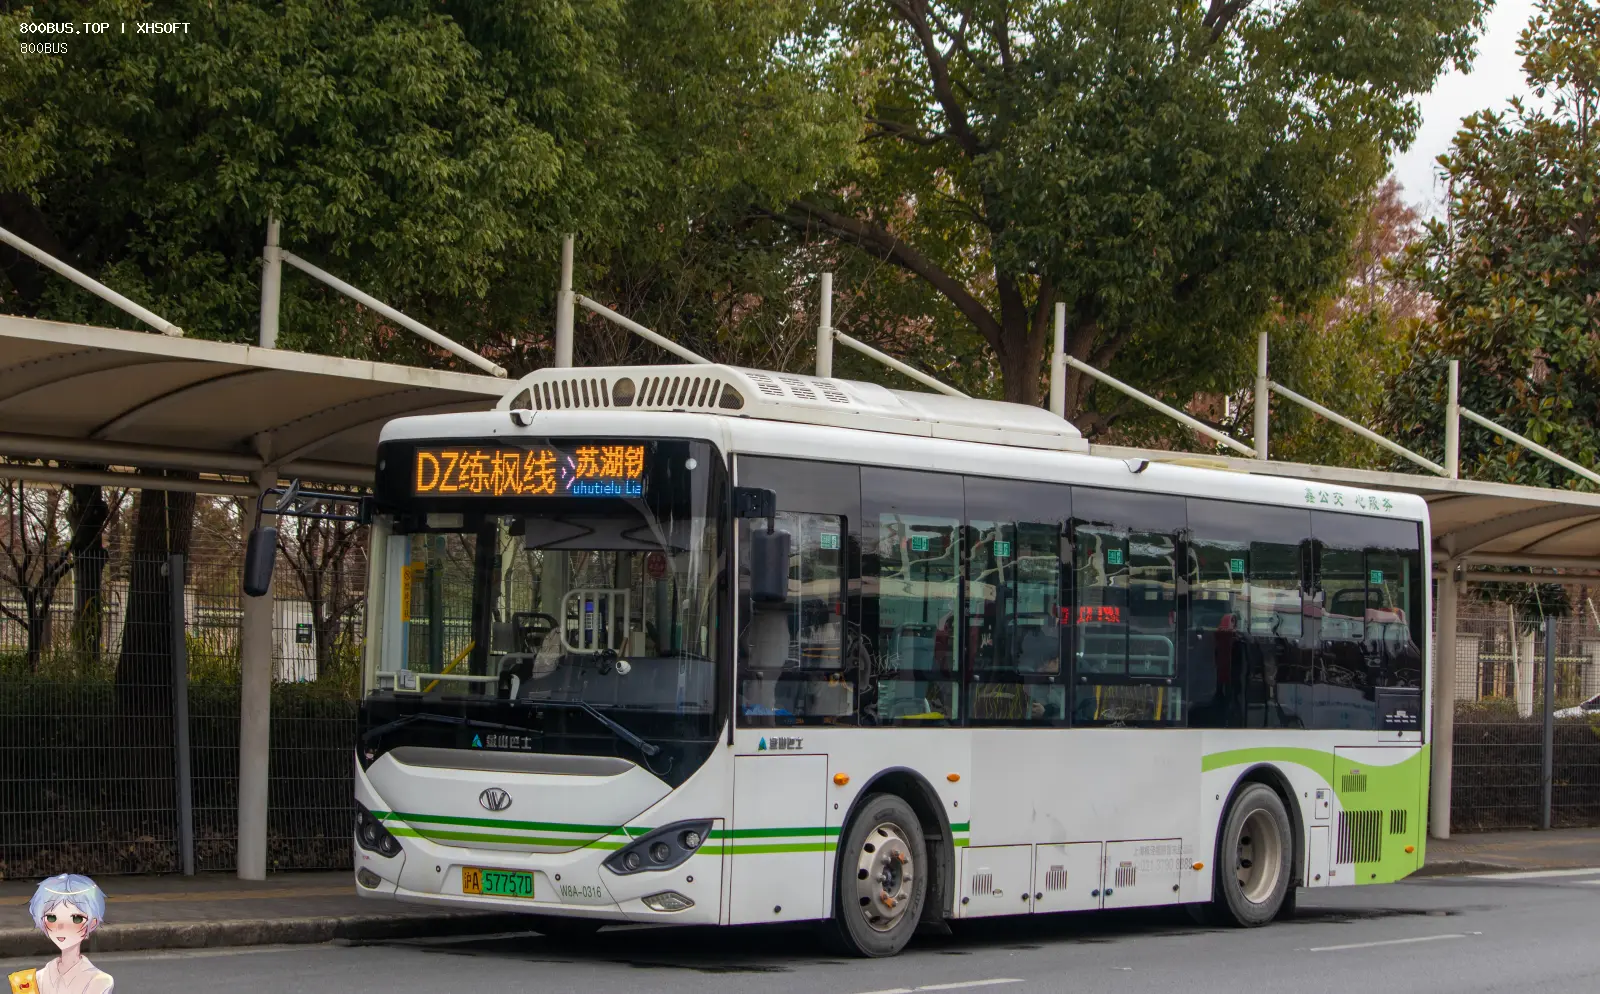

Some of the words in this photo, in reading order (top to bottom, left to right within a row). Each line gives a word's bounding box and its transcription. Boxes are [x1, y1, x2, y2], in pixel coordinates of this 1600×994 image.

[416, 450, 557, 496] DZ练枫线
[560, 884, 602, 898] W8A-0316
